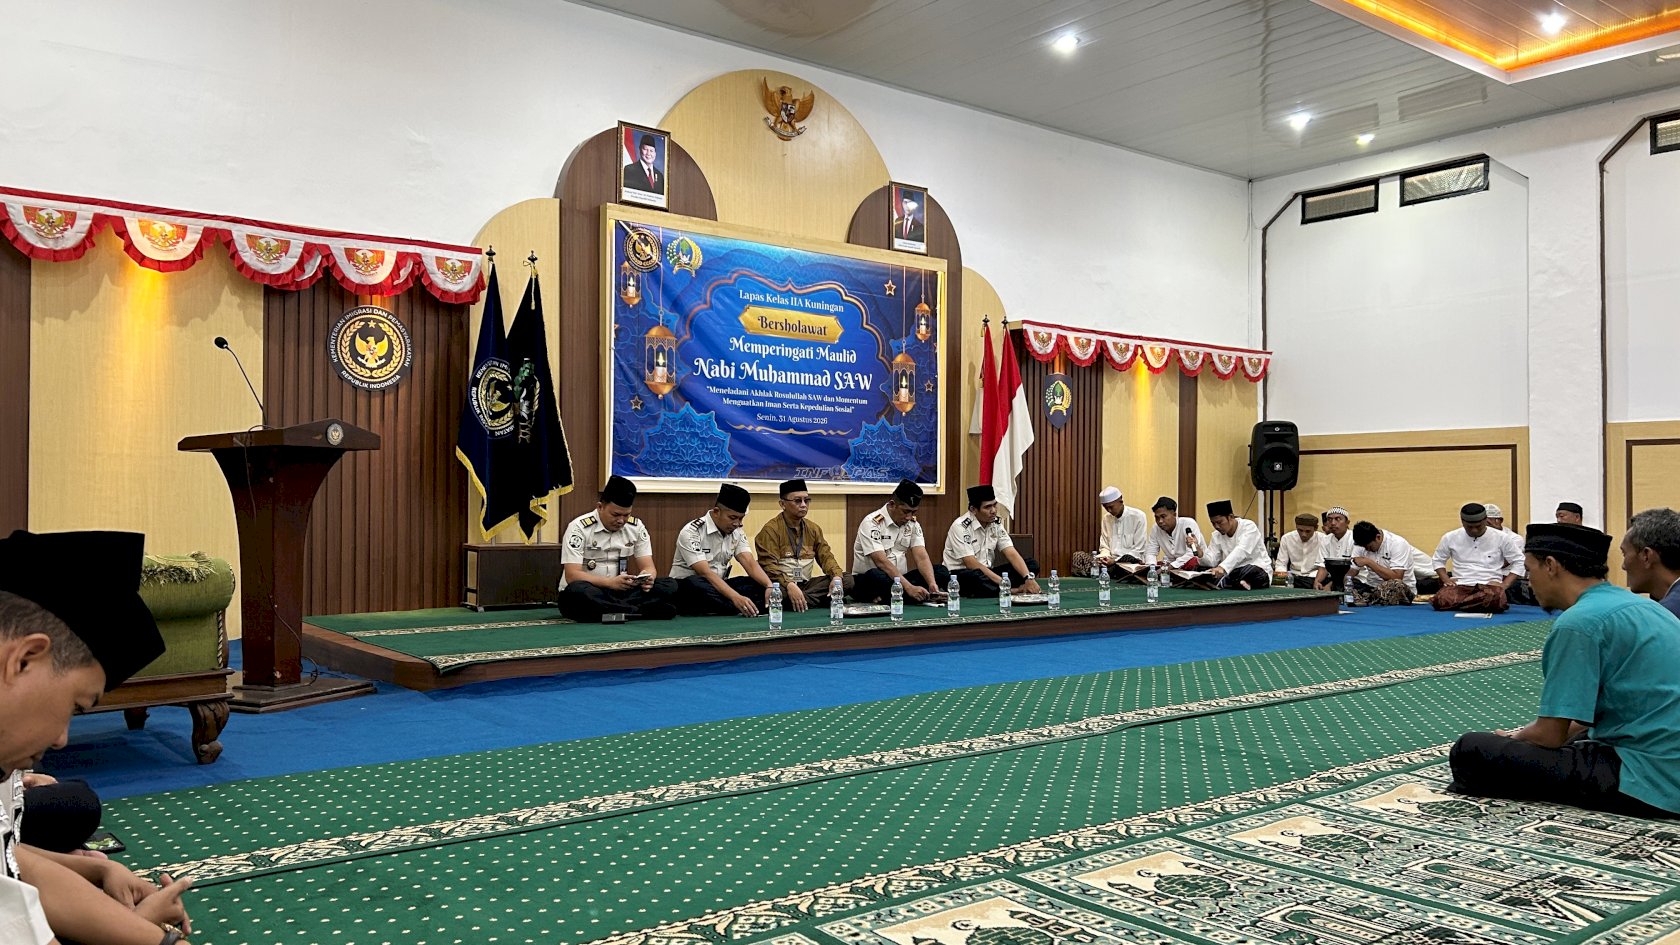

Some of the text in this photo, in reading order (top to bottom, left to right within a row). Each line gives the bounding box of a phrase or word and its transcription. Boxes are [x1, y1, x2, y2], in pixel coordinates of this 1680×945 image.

[739, 289, 844, 313] Lapas Kelas IIA Kuningan
[330, 318, 346, 363] KEMENTERIAN
[344, 308, 372, 320] IMIGRASI
[373, 308, 388, 317] DAN
[757, 315, 828, 336] Bersholawat
[729, 335, 857, 364] Memperingati Maulid
[341, 370, 401, 389] REPUBLIK INDONESIA
[692, 357, 873, 391] Nabi Muhammad SAW
[722, 397, 764, 408] Menguatkan
[765, 400, 782, 409] Iman
[783, 402, 800, 410] Serta
[800, 403, 834, 412] Kepedulian
[750, 389, 774, 398] Akhlak
[774, 391, 808, 400] Rosulullah
[808, 393, 823, 402] SAW
[823, 394, 835, 402] dan
[835, 395, 868, 405] Momentum
[787, 415, 813, 424] Agustus
